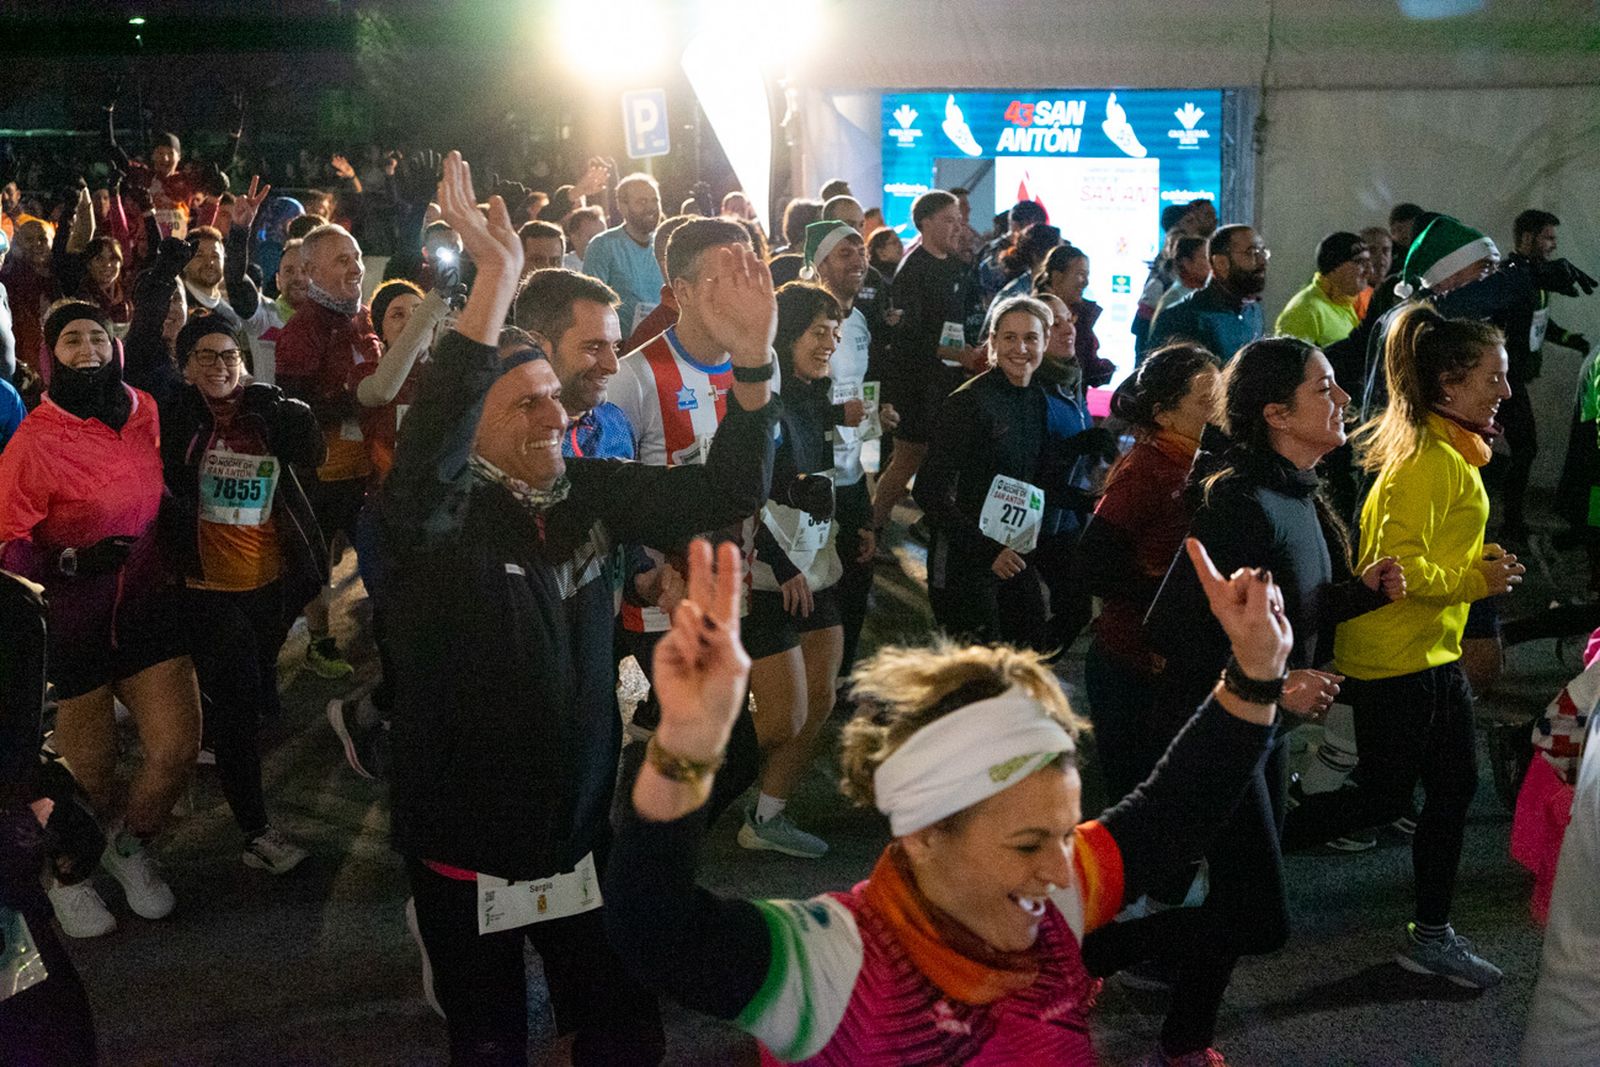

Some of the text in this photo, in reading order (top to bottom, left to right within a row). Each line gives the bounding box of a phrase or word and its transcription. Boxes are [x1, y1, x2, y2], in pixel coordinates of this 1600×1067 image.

[632, 98, 658, 149] P
[996, 124, 1082, 153] ANTÓN
[212, 476, 261, 501] 7855
[1000, 503, 1027, 528] 277
